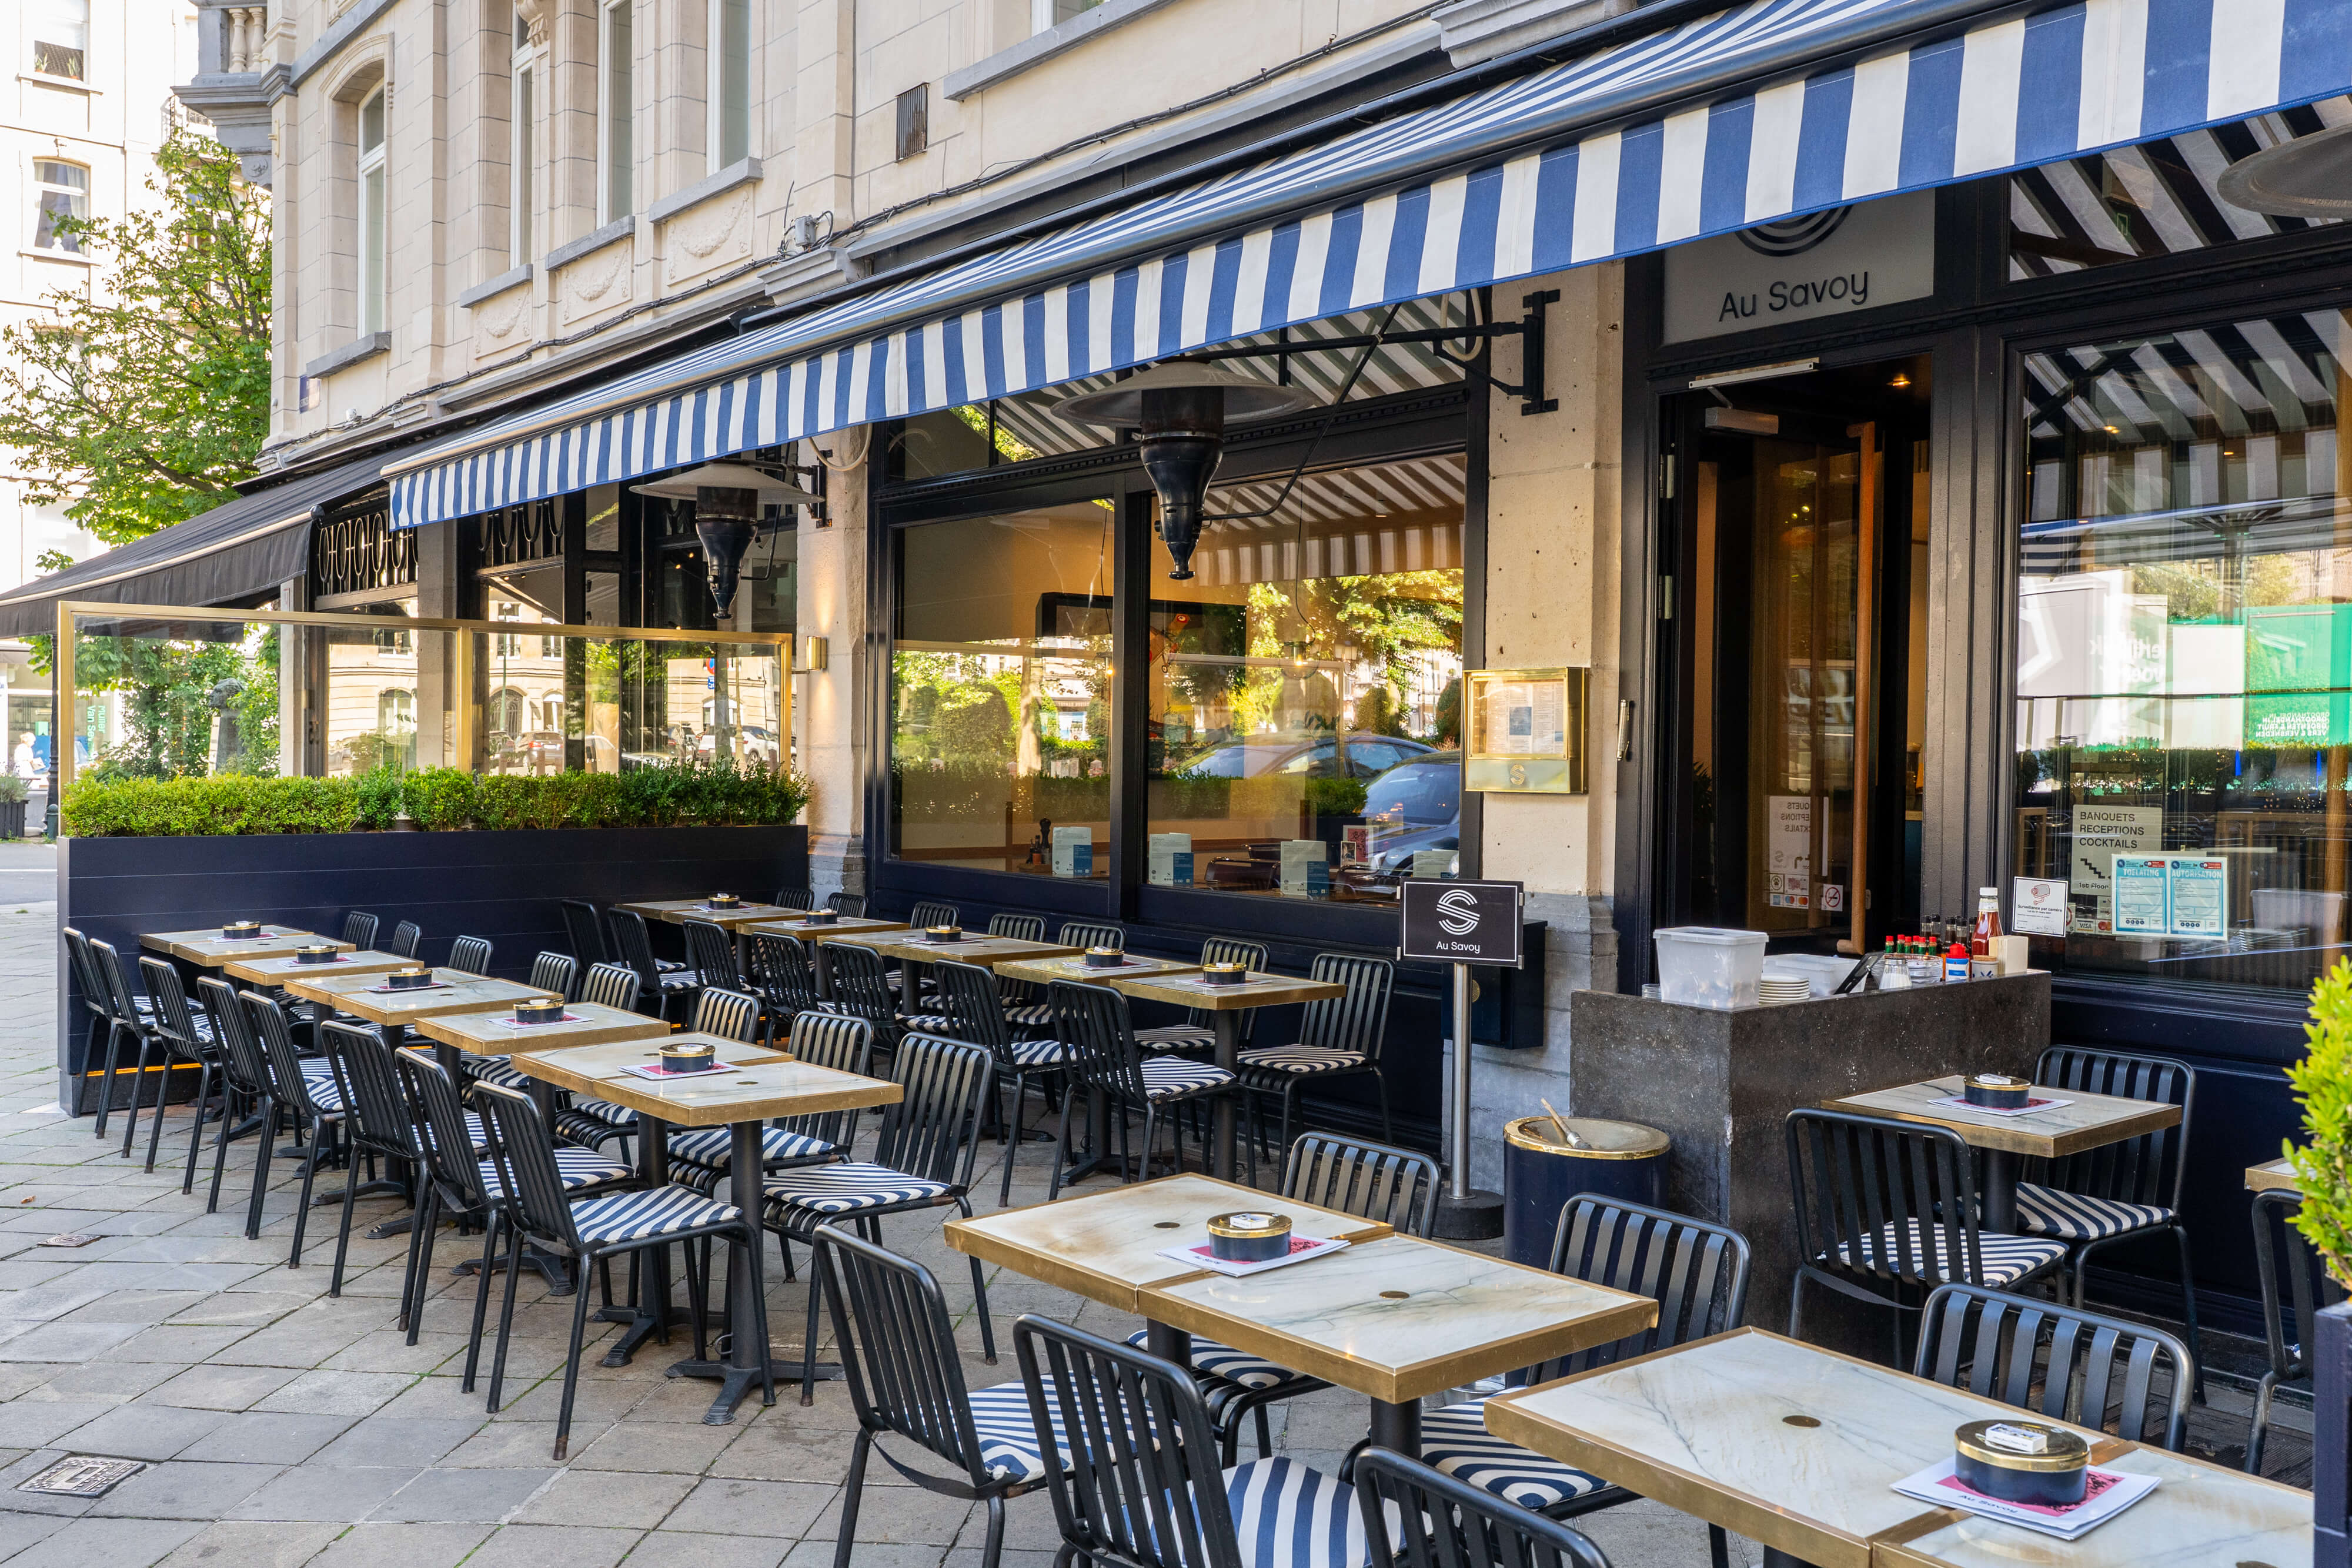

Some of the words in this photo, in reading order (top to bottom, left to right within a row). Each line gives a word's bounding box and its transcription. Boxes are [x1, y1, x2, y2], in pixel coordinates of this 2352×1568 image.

[1718, 292, 1756, 322] Au
[1768, 271, 1868, 312] Savoy
[2080, 811, 2135, 822] BANQUETS
[2079, 824, 2144, 835] RECEPTIONS
[2079, 837, 2137, 848] COCKTAILS
[2123, 868, 2160, 877] TOELATING
[2171, 870, 2222, 878] AUTORISATION
[1436, 941, 1448, 950] Au
[1451, 941, 1481, 954] Savoy
[1979, 1499, 2019, 1513] Savoy
